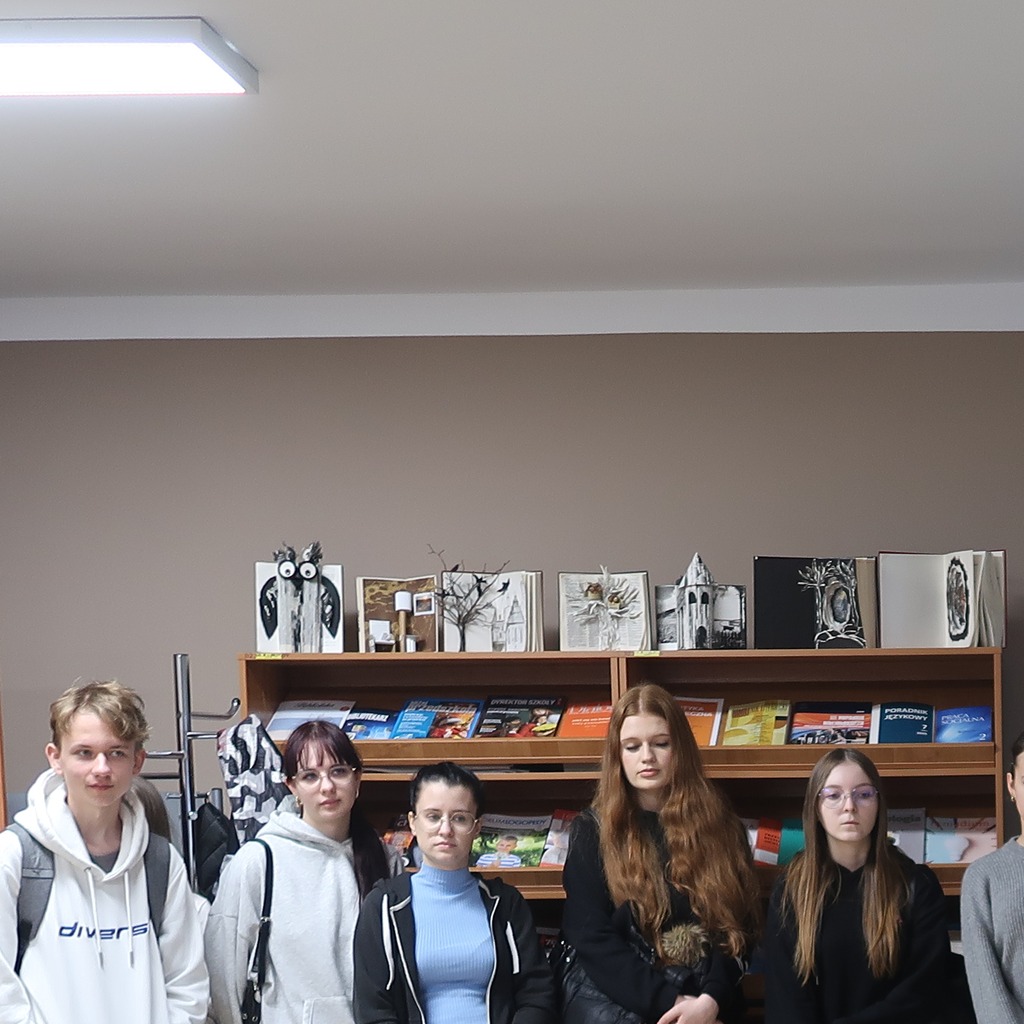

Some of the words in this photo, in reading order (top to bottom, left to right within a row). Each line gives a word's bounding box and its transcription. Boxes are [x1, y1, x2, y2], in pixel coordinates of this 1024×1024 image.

[884, 707, 928, 715] PORADNIK
[941, 713, 969, 721] PRACA
[979, 733, 987, 741] 2
